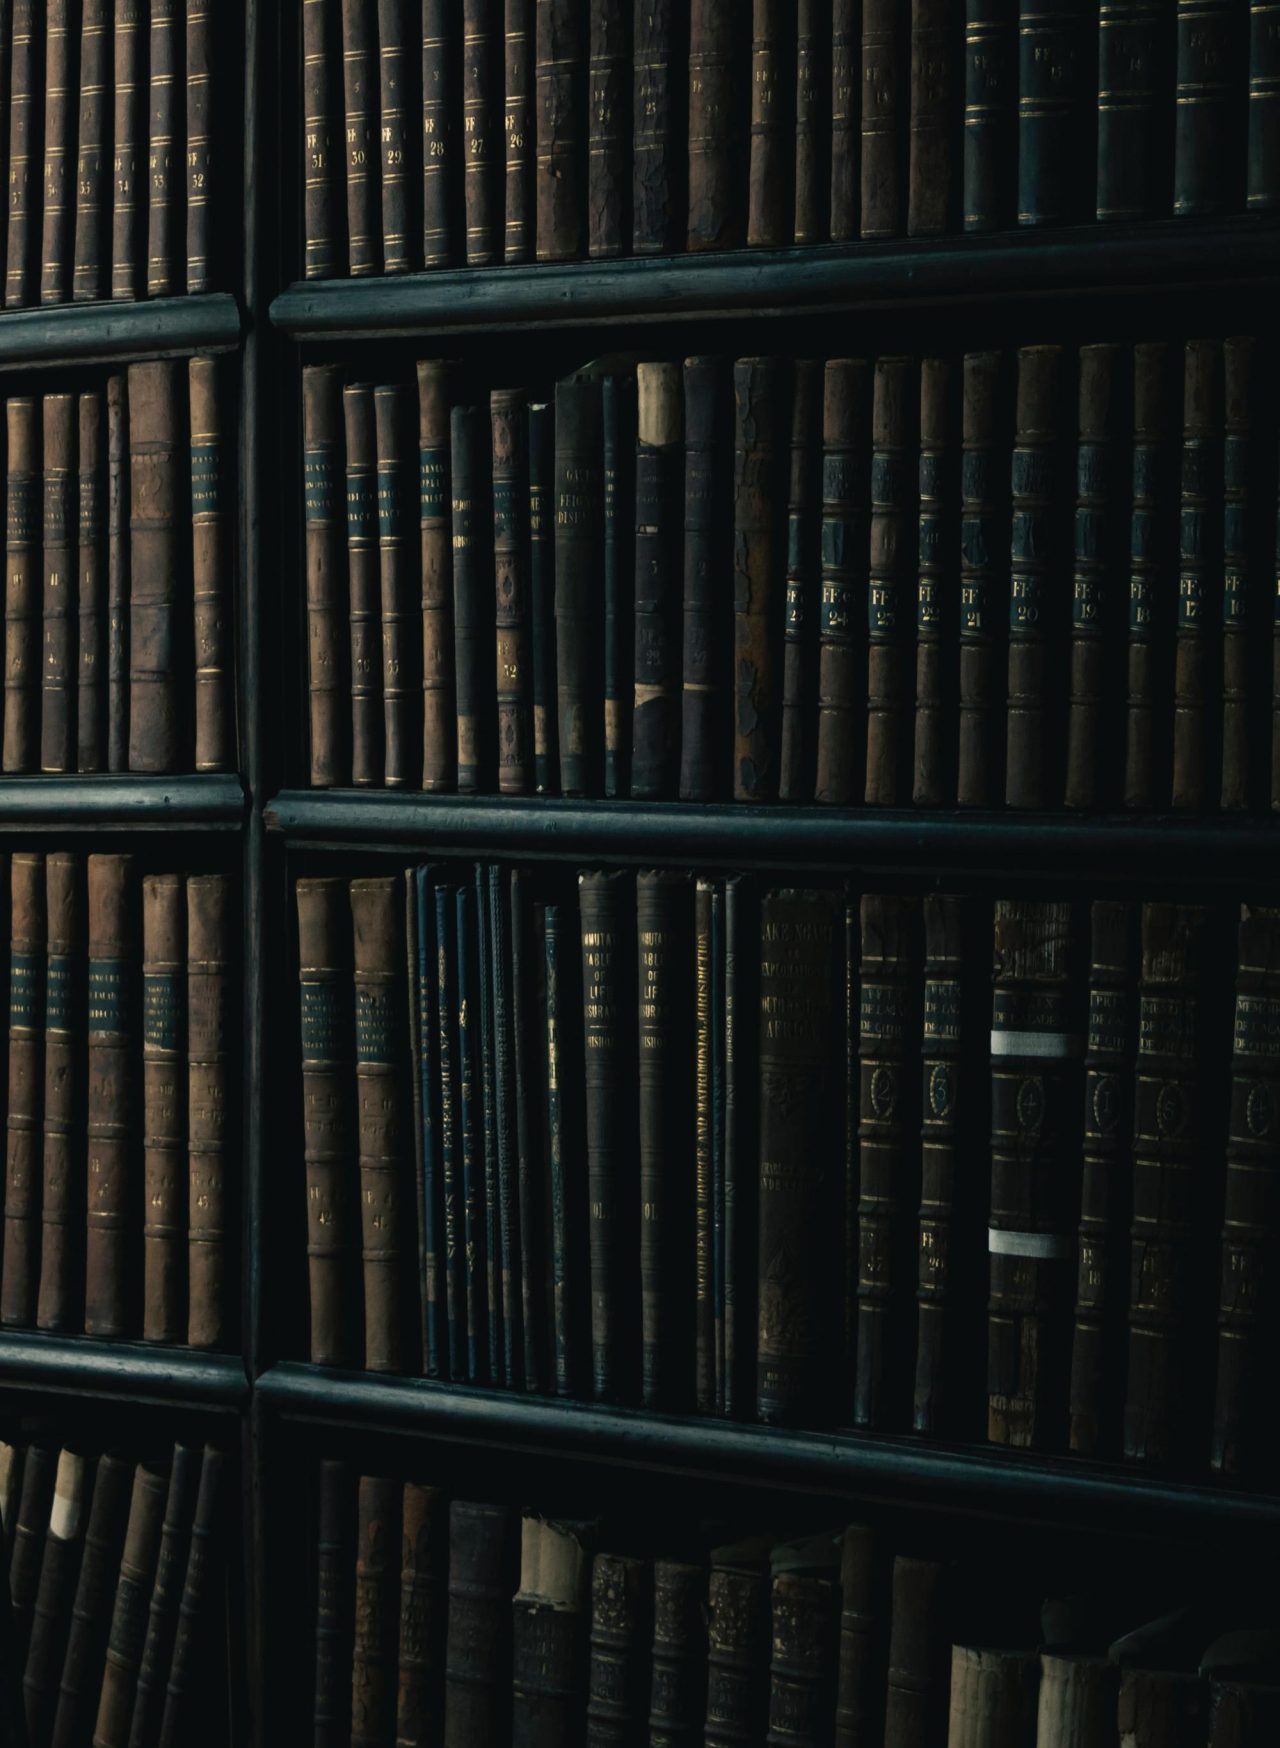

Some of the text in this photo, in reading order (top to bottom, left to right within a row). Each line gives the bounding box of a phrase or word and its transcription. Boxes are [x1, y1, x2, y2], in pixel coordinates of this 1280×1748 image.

[1018, 605, 1039, 624] 20
[643, 985, 658, 999] LIF
[877, 1079, 891, 1101] 2
[935, 1078, 947, 1101] 3
[1022, 1091, 1040, 1116] 4
[696, 1116, 708, 1144] AND
[696, 1148, 708, 1202] DIVORCE
